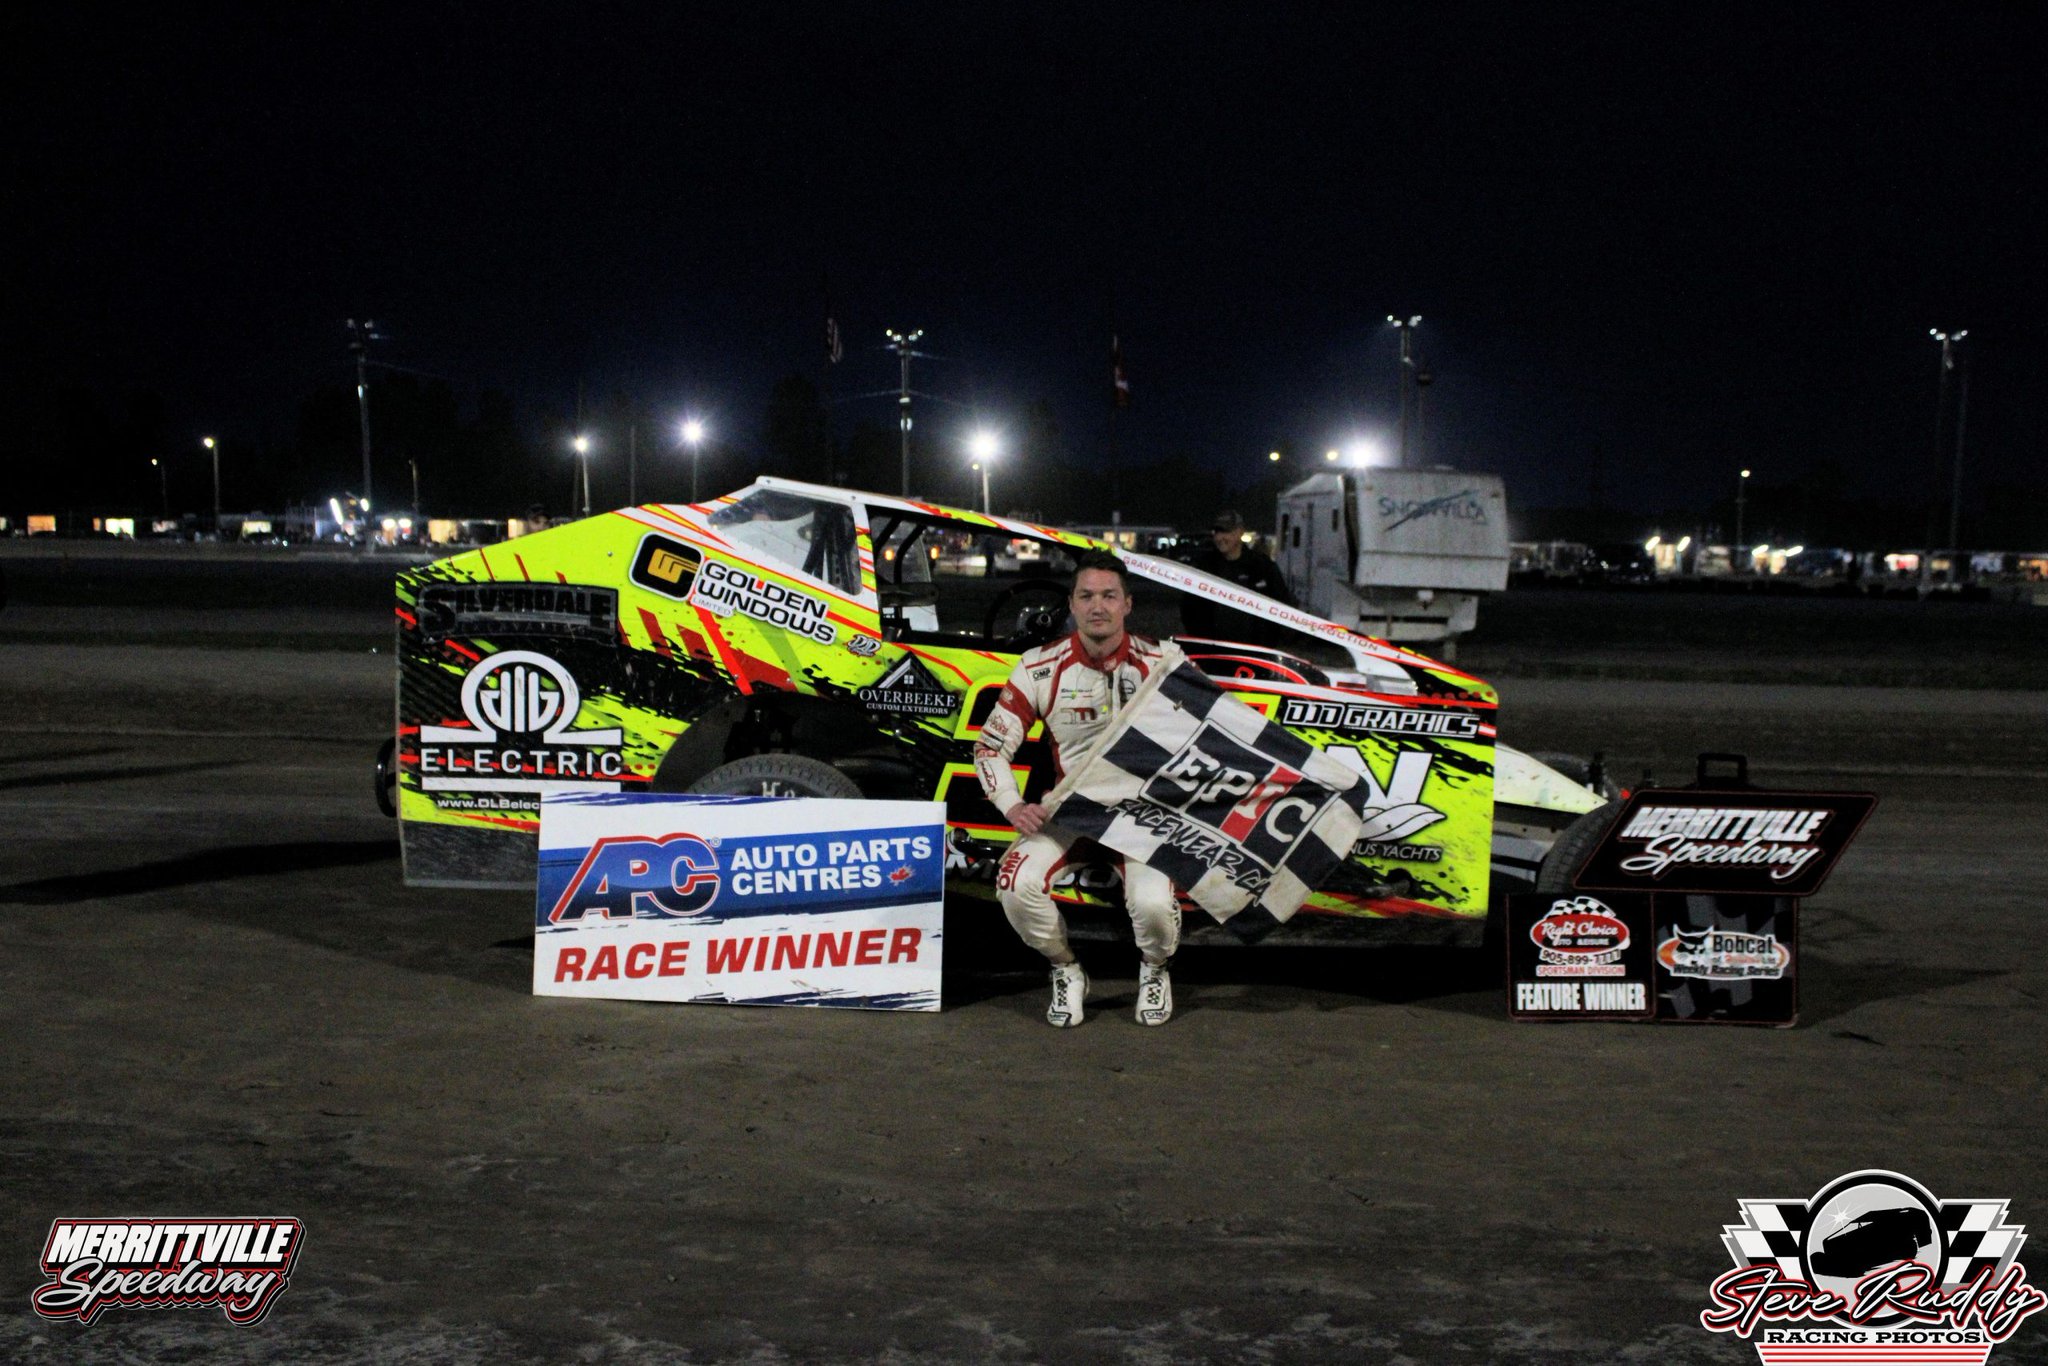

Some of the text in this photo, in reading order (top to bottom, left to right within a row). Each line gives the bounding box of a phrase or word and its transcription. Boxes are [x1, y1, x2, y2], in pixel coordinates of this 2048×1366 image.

[705, 562, 826, 618] GOLDEN
[692, 597, 732, 616] LIMITED
[698, 579, 834, 641] WINDOWS
[1198, 582, 1262, 611] GENERAL
[1268, 607, 1378, 650] CONSTRUCTION
[1033, 668, 1051, 680] OMP
[859, 689, 956, 707] OVERBEEKE
[866, 703, 948, 714] CUSTOM EXTERIORS
[1344, 708, 1479, 736] GRAPHICS
[420, 748, 624, 777] ELECTRIC
[437, 798, 540, 810] www.DLBelec
[1167, 744, 1308, 843] EPIC
[1621, 806, 1830, 843] MERRITTVILLE
[730, 836, 932, 873] AUTO PARTS
[1350, 843, 1442, 861] NUS YACHTS
[1621, 833, 1820, 880] Speedway
[549, 832, 721, 925] APC
[732, 865, 882, 896] CENTRES
[1542, 922, 1618, 946] Right Choice
[1713, 935, 1773, 954] Bobcat
[554, 927, 922, 983] RACE WINNER
[1537, 966, 1625, 976] SPORTSMAN DIVISION
[1711, 965, 1744, 977] Racing
[1747, 966, 1780, 977] Series
[1517, 983, 1646, 1011] FEATURE WINNER
